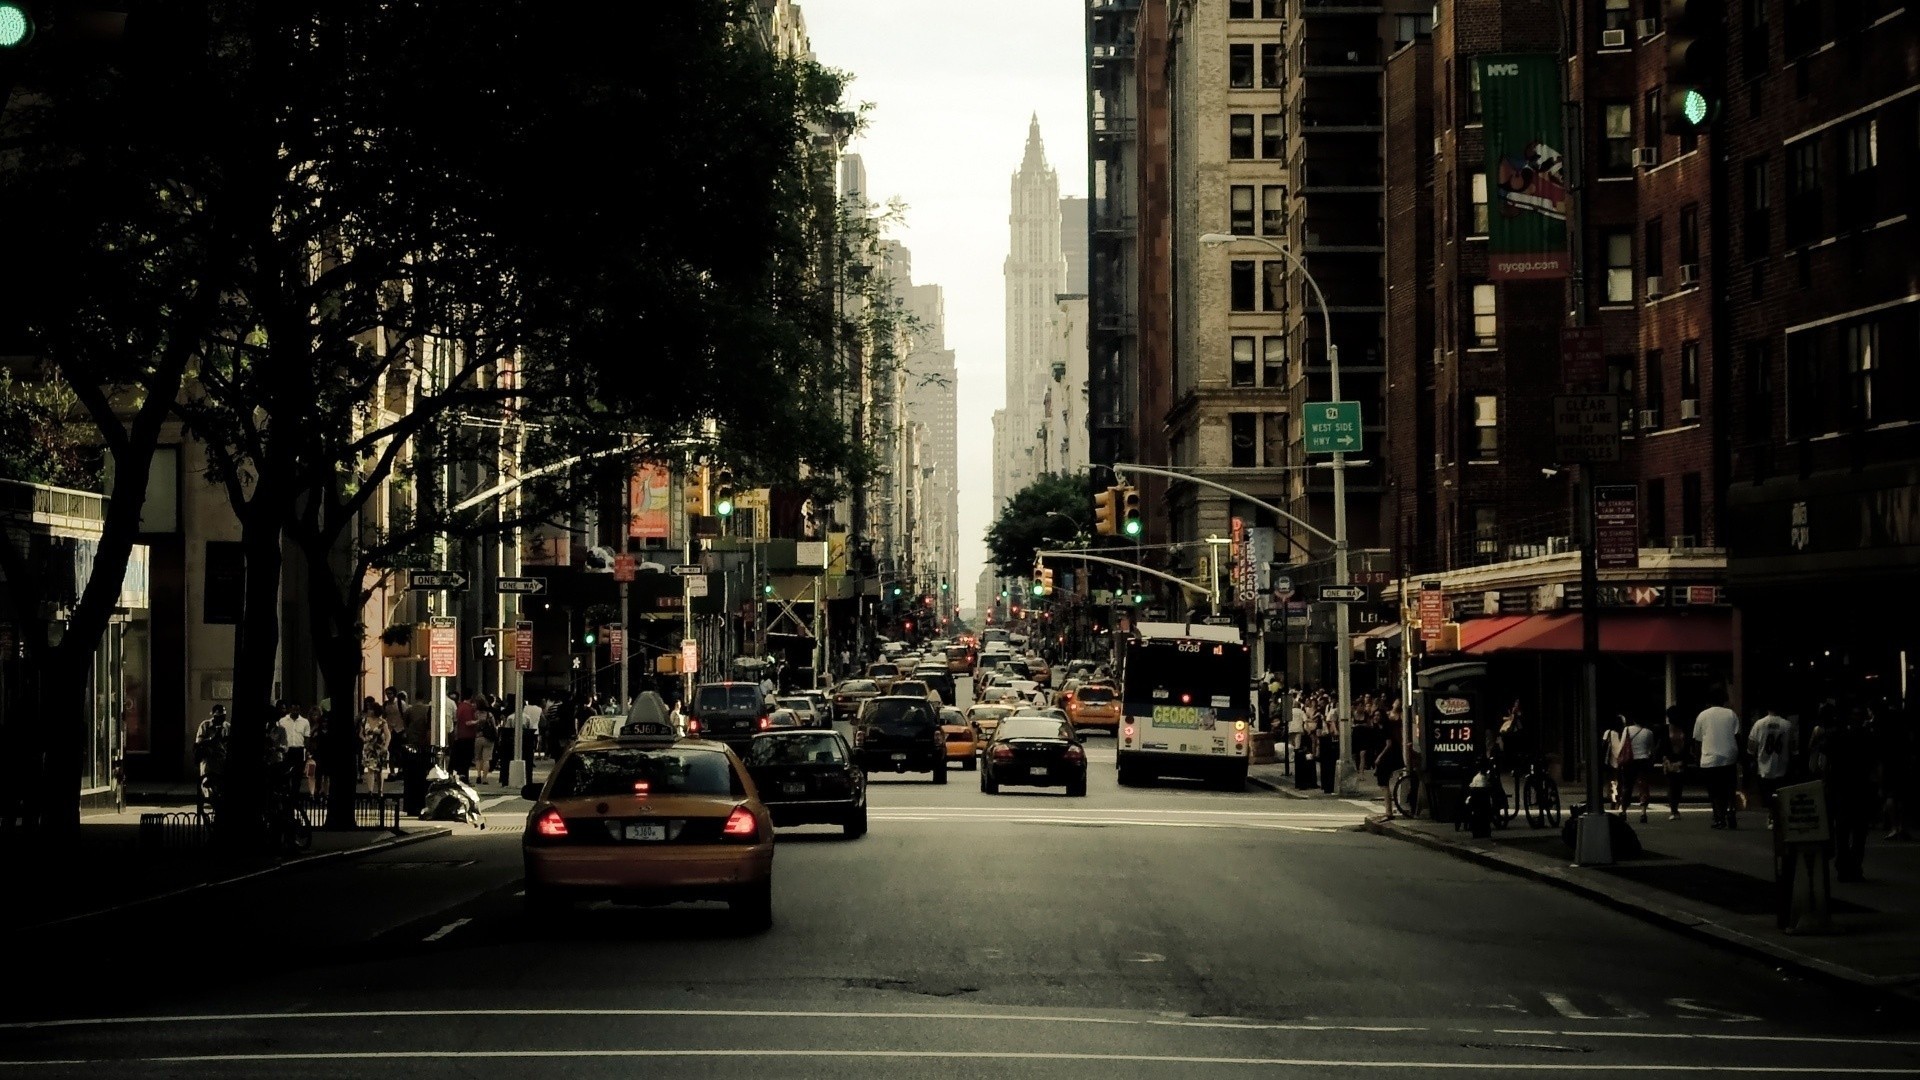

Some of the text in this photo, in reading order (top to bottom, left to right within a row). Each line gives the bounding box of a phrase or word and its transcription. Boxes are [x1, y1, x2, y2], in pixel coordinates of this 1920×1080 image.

[1487, 63, 1519, 77] NYC
[1498, 260, 1559, 274] nycgo.com
[1566, 399, 1606, 411] CLEAR
[1560, 413, 1612, 423] FIRE LANE
[1312, 422, 1353, 432] WEST SIDE
[1313, 437, 1330, 446] HWY
[1556, 434, 1618, 446] EMERGENCY
[1563, 447, 1613, 459] VEHICLES
[418, 576, 436, 585] ONE
[1354, 573, 1361, 583] E
[1375, 573, 1384, 583] ST
[503, 581, 539, 589] ONE WAY
[1346, 589, 1361, 597] WAY
[1178, 643, 1200, 653] 6738
[634, 723, 656, 734] 5J60
[1450, 726, 1471, 740] 113
[1433, 743, 1474, 752] MILLION
